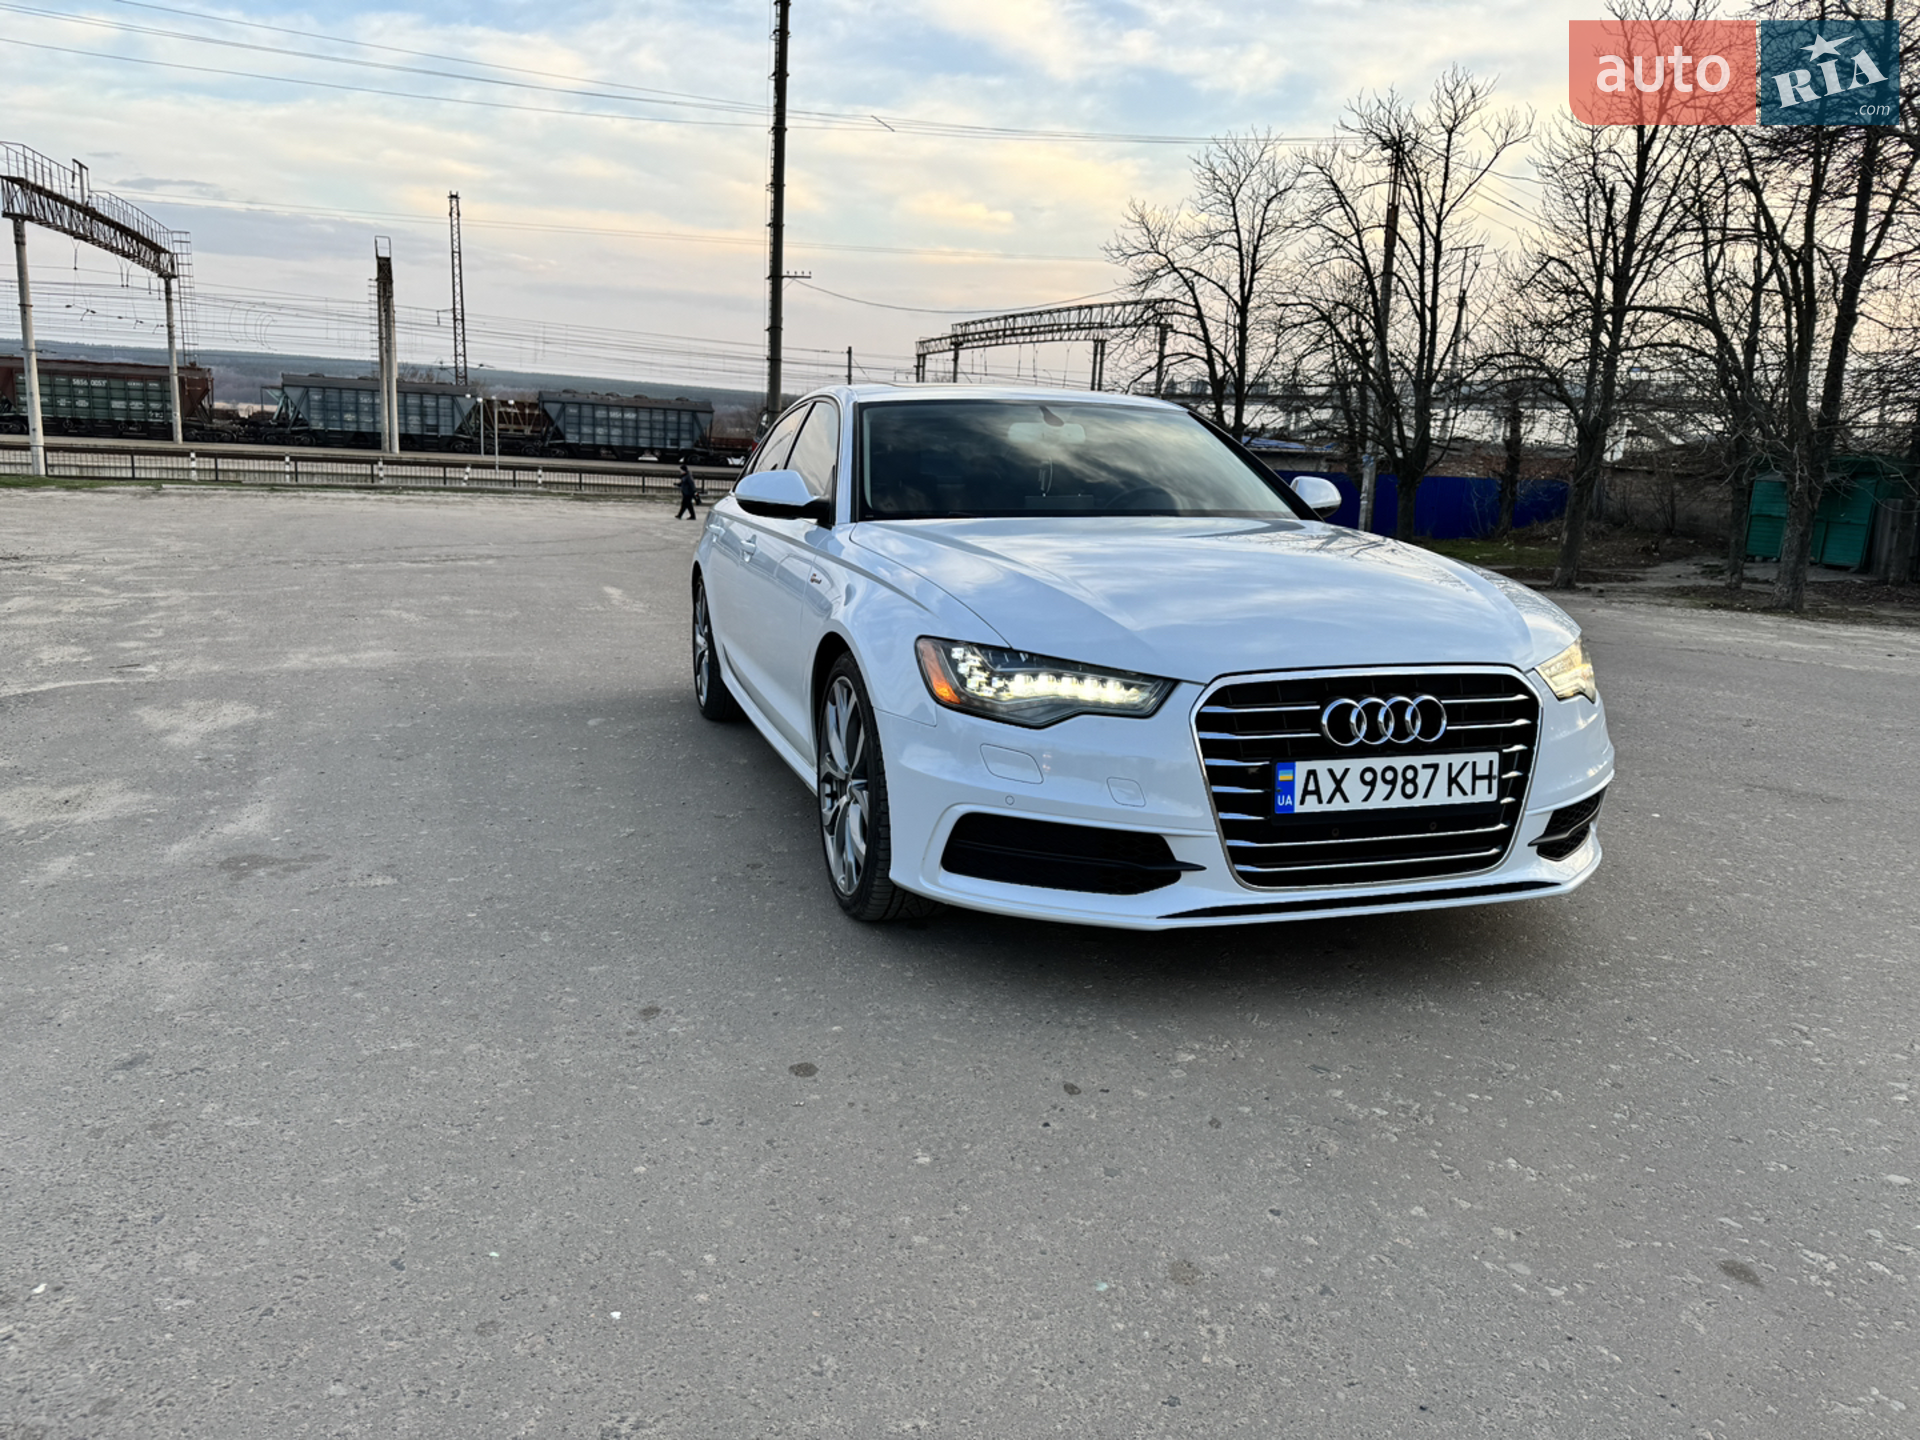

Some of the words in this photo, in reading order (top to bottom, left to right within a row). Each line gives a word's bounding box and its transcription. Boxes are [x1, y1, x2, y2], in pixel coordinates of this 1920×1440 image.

[1299, 767, 1351, 806] AX
[1359, 763, 1440, 803] 9987
[1447, 759, 1494, 798] KH
[1277, 794, 1293, 806] UA
